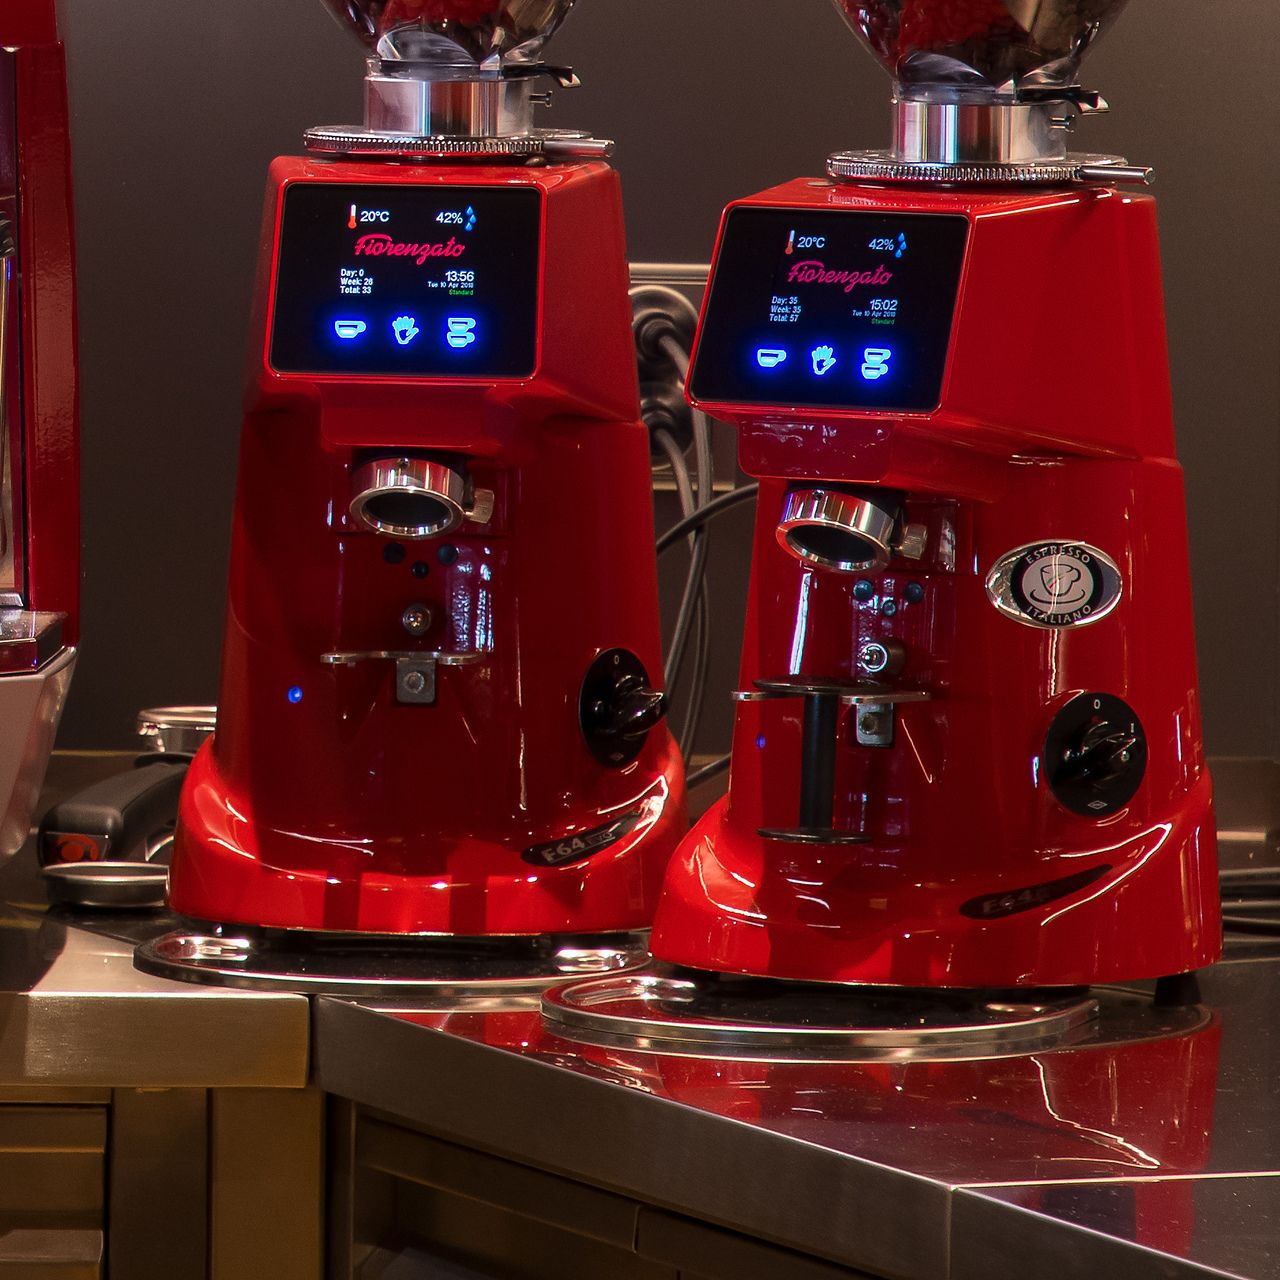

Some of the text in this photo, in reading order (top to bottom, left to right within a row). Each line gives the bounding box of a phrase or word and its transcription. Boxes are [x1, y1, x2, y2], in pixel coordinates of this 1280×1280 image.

[359, 210, 463, 224] 20°C 42%
[797, 236, 895, 251] 20°C 42%
[354, 233, 466, 266] Fiorenzato
[340, 268, 365, 278] Day: 0
[444, 271, 475, 282] 13:56
[787, 260, 894, 293] Fiorenzato
[340, 277, 362, 286] Week:
[448, 281, 459, 289] Apr
[340, 285, 372, 294] Total: 33
[771, 296, 799, 306] Day: 35
[869, 299, 899, 311] 15:02
[770, 305, 802, 314] Week: 35
[852, 309, 862, 317] Tue
[871, 310, 882, 318] Apr
[769, 313, 800, 322] Total: 57
[1025, 545, 1091, 565] ESPRESSO
[1026, 604, 1092, 624] ITALIANO
[1093, 699, 1101, 710] 0
